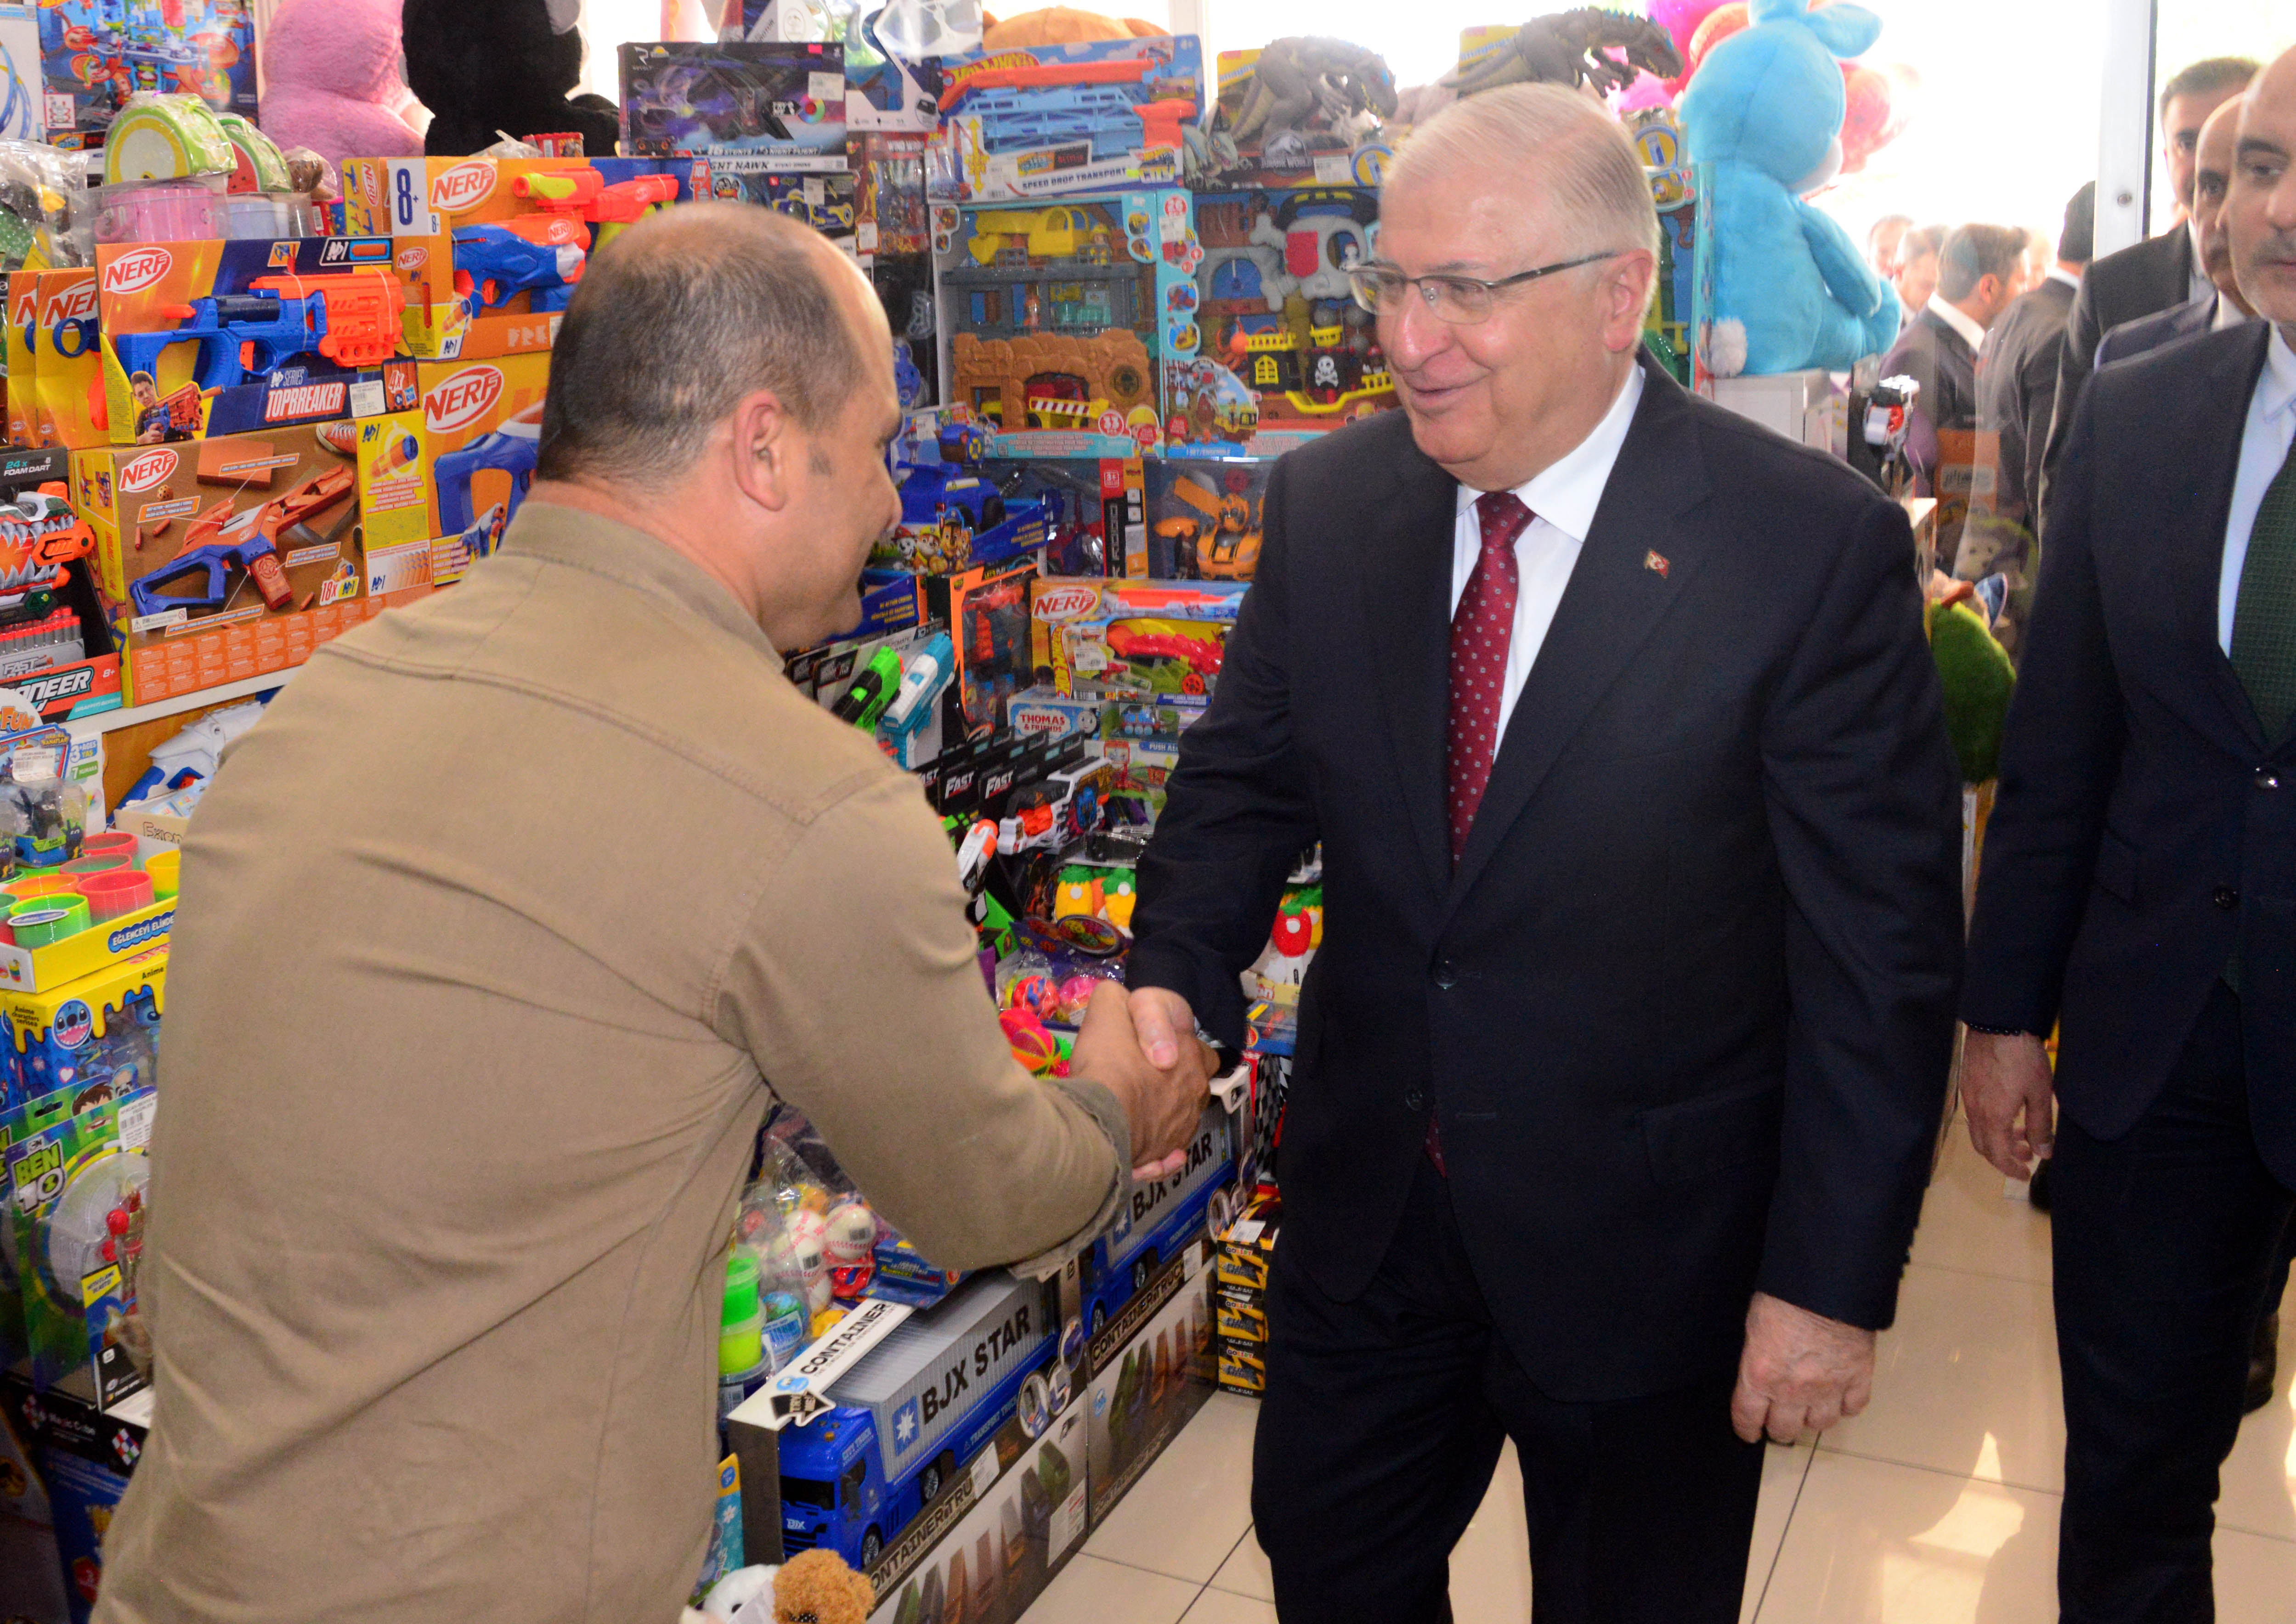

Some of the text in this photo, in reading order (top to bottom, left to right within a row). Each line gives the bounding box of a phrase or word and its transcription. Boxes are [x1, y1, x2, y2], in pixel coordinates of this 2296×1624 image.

[364, 164, 376, 205] NERF
[432, 167, 493, 205] NERF
[1022, 168, 1126, 190] SPEED DROP TRANSPORT
[105, 253, 170, 290] NERF
[398, 250, 427, 266] NERF
[283, 368, 305, 386] SERIES
[266, 383, 344, 418] TOPBREAKER
[424, 370, 501, 421] NERF
[4, 464, 51, 476] FOAM DART
[6, 460, 21, 469] 24
[121, 453, 176, 488] NERF
[322, 581, 338, 602] 18x
[1033, 588, 1098, 618] NERF
[4, 657, 36, 675] FAST
[102, 668, 115, 678] 8+
[1, 706, 35, 731] FUN
[1020, 713, 1066, 726] THOMAS
[1149, 741, 1166, 751] PUSH
[944, 770, 975, 800] FAST
[985, 769, 1013, 799] FAST
[113, 923, 150, 946] EĞLENCEYİ
[141, 966, 164, 980] Anime
[15, 1006, 34, 1015] Anime
[14, 1142, 62, 1189] BEN
[18, 1167, 65, 1213] 10
[1131, 1181, 1168, 1224] BJX
[1092, 1259, 1185, 1361] CONTAINER TRUC
[800, 1303, 887, 1375] CONTAINER
[922, 1304, 1031, 1426] BJX STAR
[870, 1509, 944, 1590] ONTAINER
